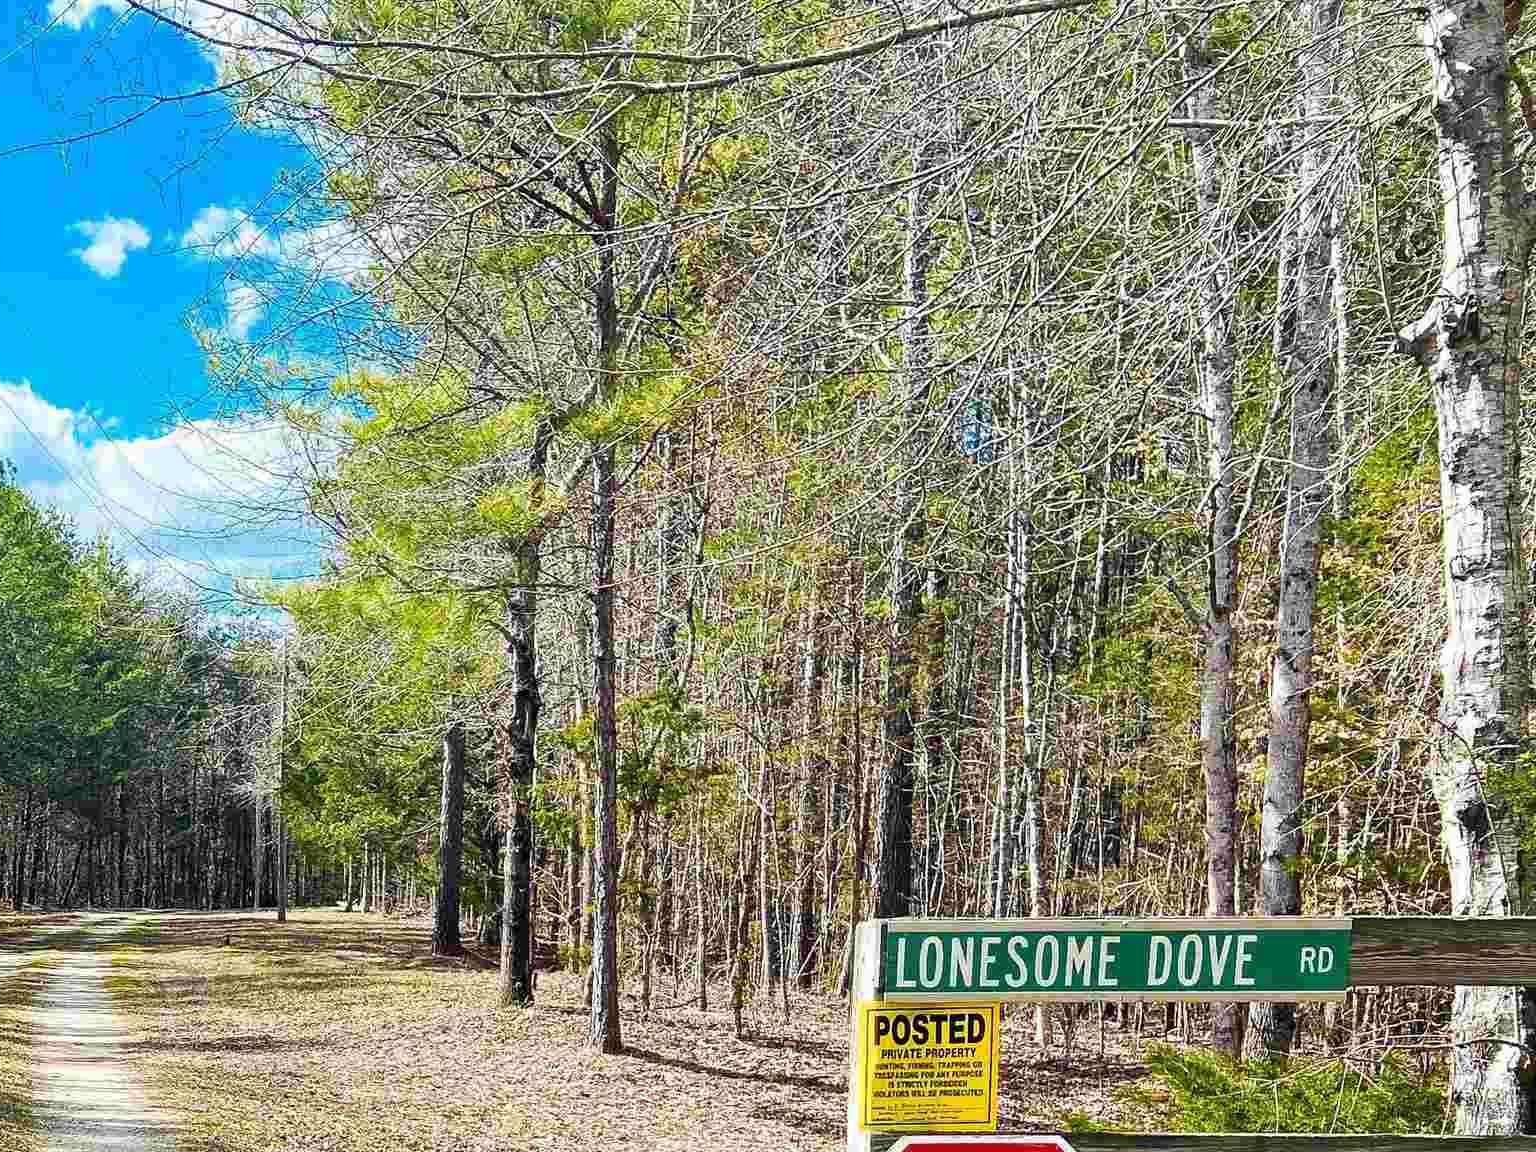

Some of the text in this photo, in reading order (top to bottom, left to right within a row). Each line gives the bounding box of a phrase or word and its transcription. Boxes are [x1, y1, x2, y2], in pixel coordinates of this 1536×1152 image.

[895, 934, 1335, 988] LONESOME DOVE RD
[874, 1013, 986, 1045] POSTED
[881, 1048, 977, 1059] PRIVATE PROPERTY
